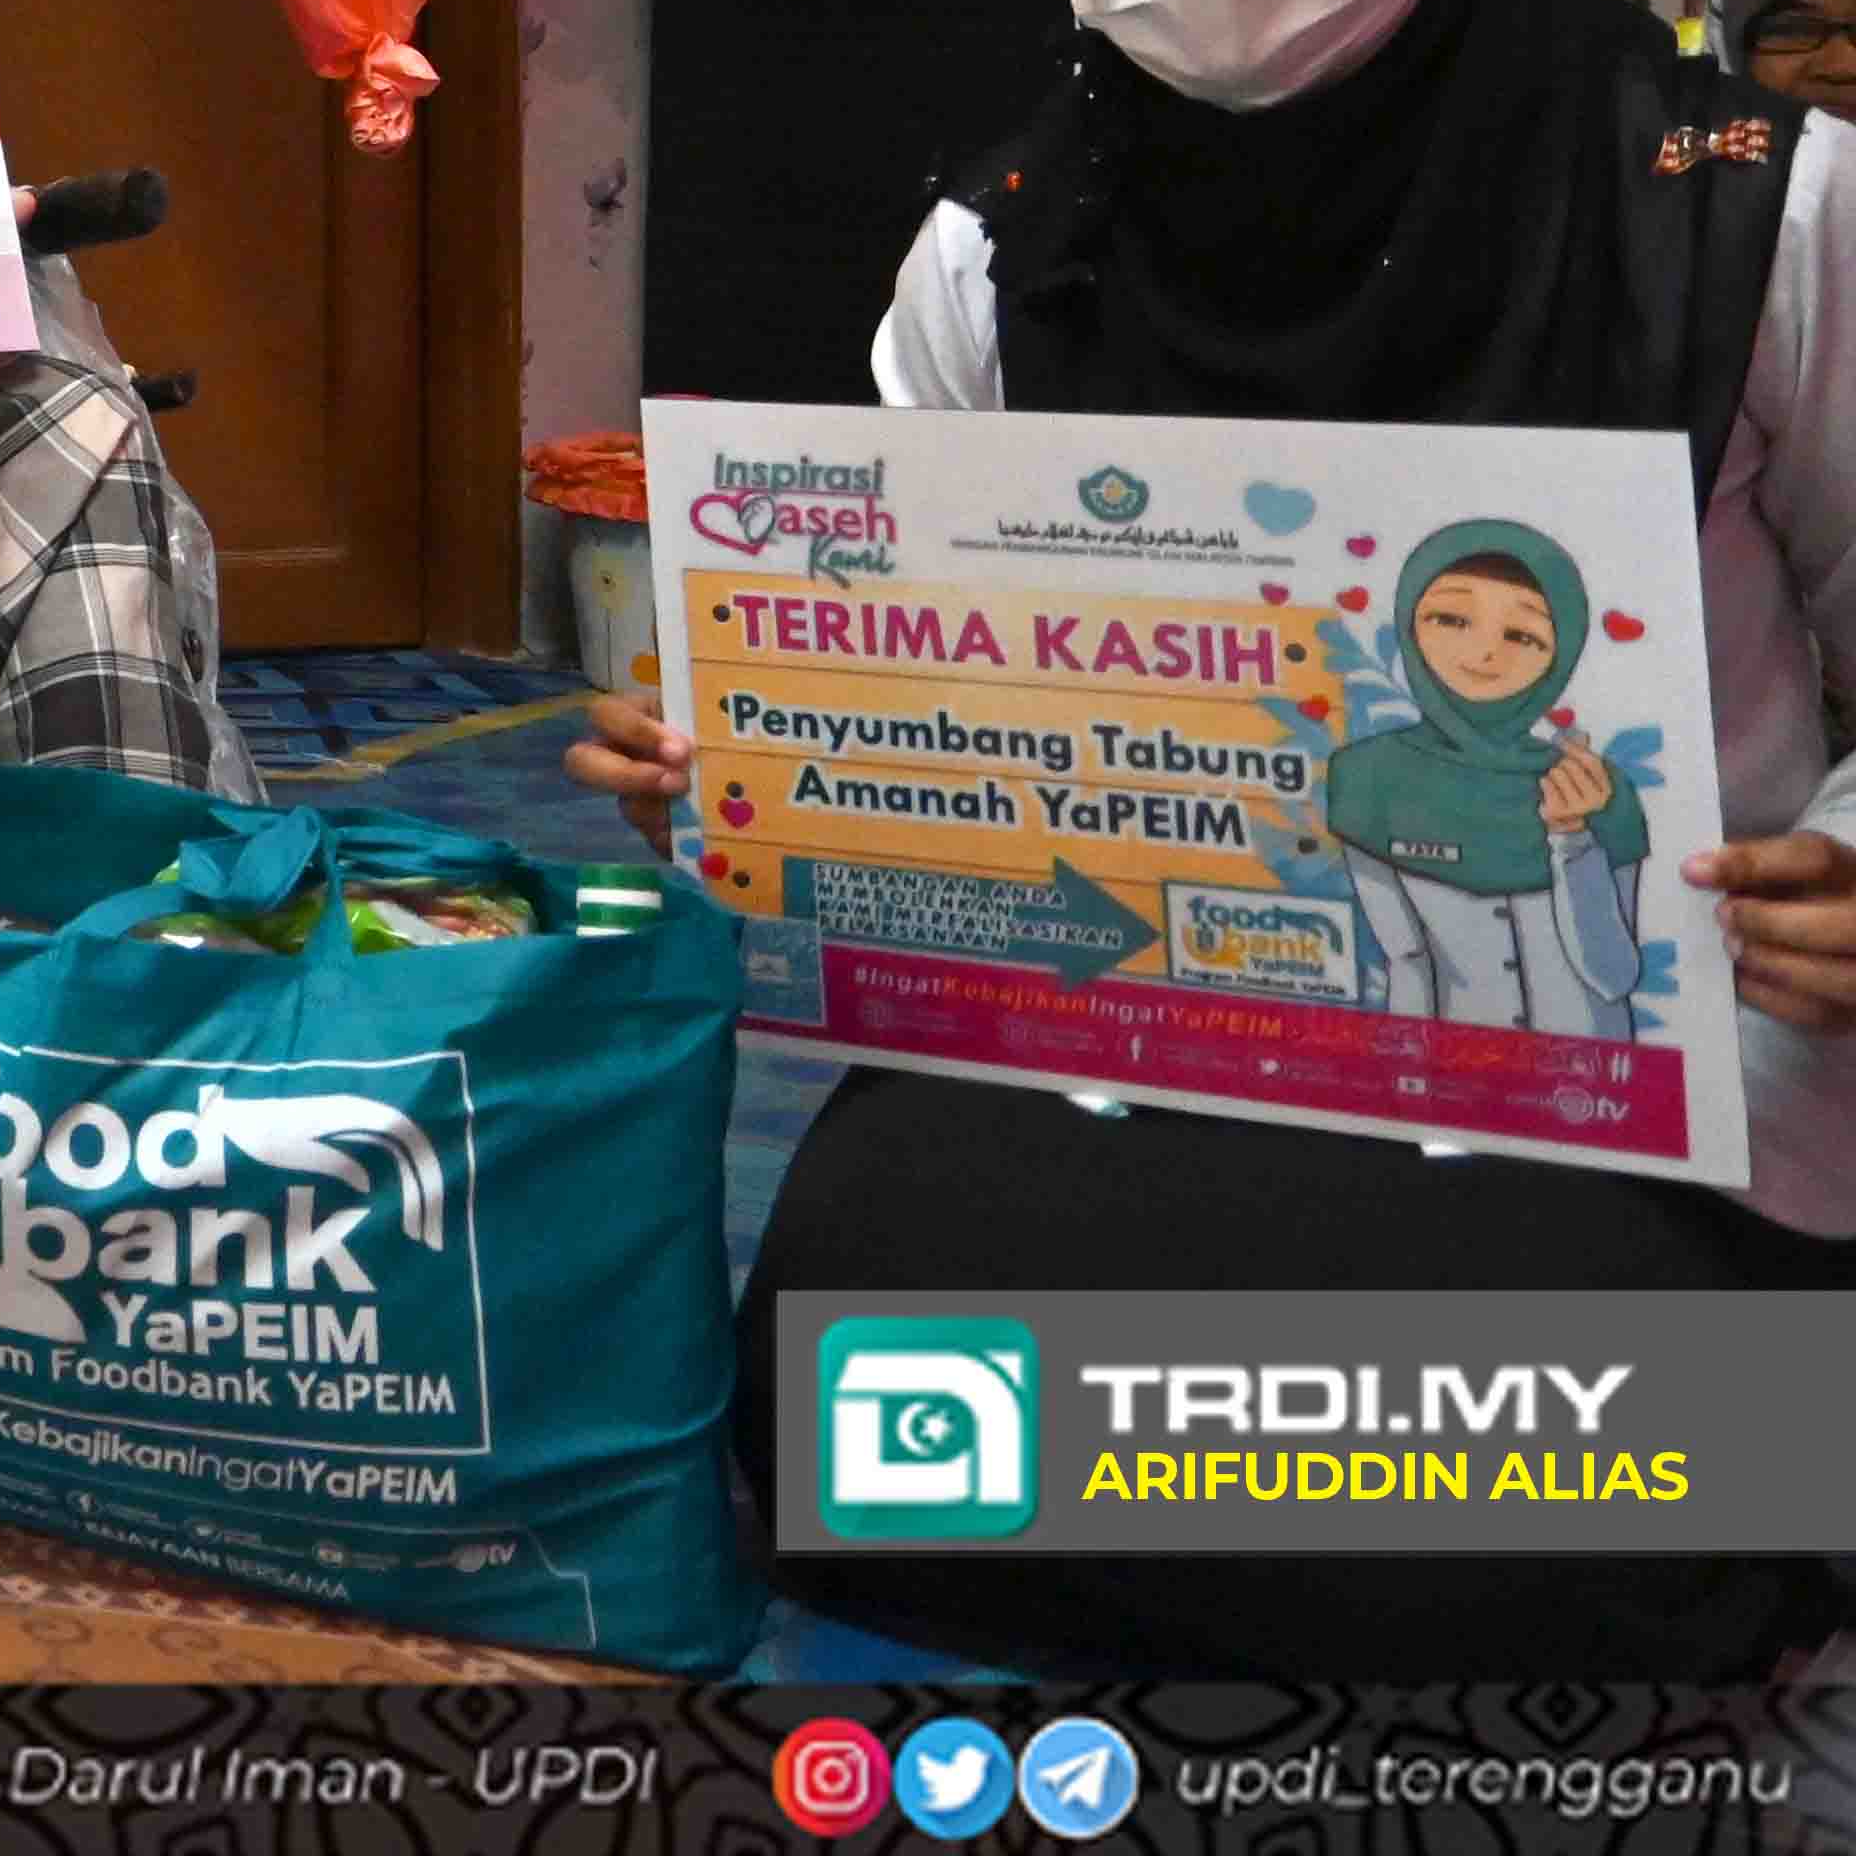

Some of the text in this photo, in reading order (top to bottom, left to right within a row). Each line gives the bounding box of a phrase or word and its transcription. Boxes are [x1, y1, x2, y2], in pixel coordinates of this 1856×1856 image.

[715, 452, 884, 494] Inspirasi
[734, 594, 1276, 685] TERIMA KASIH
[733, 694, 1305, 793] Penyumbang Tabung
[795, 764, 1245, 846] Amanah YaPEIM
[816, 864, 1066, 907] SUMBANGAN ANDA
[817, 882, 1014, 916] MEMBOLEHKAN
[818, 899, 883, 921] KAMI
[1190, 895, 1281, 931] food
[2, 1174, 377, 1293] bank
[101, 1290, 380, 1366] YaPEIM
[51, 1347, 273, 1407] Foodbank
[288, 1370, 457, 1415] YaPEIM
